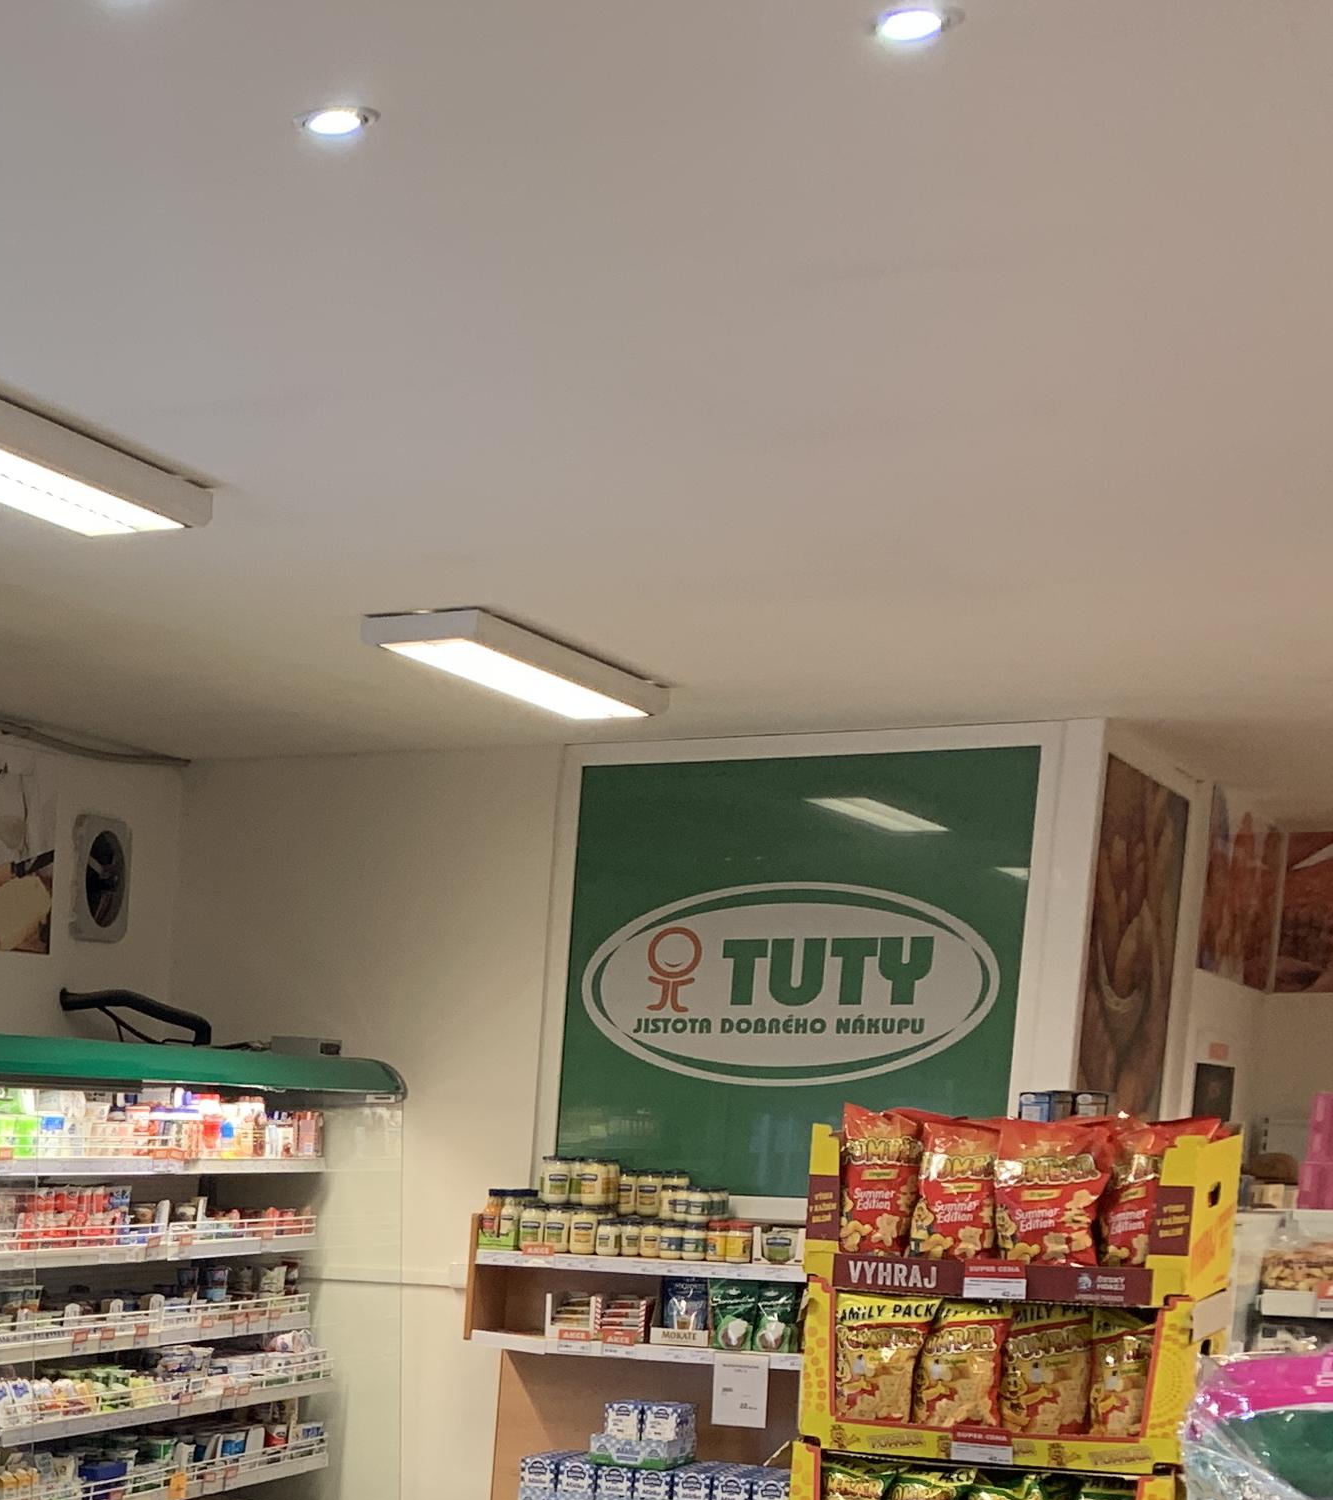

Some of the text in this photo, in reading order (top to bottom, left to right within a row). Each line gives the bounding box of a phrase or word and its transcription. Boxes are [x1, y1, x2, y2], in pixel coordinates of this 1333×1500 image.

[722, 936, 935, 1006] TUTY
[633, 1013, 925, 1035] JISTOTA DOBRÉHO NÁKUPU
[847, 1259, 937, 1288] VYHRAJ
[660, 1330, 698, 1342] MOKATE
